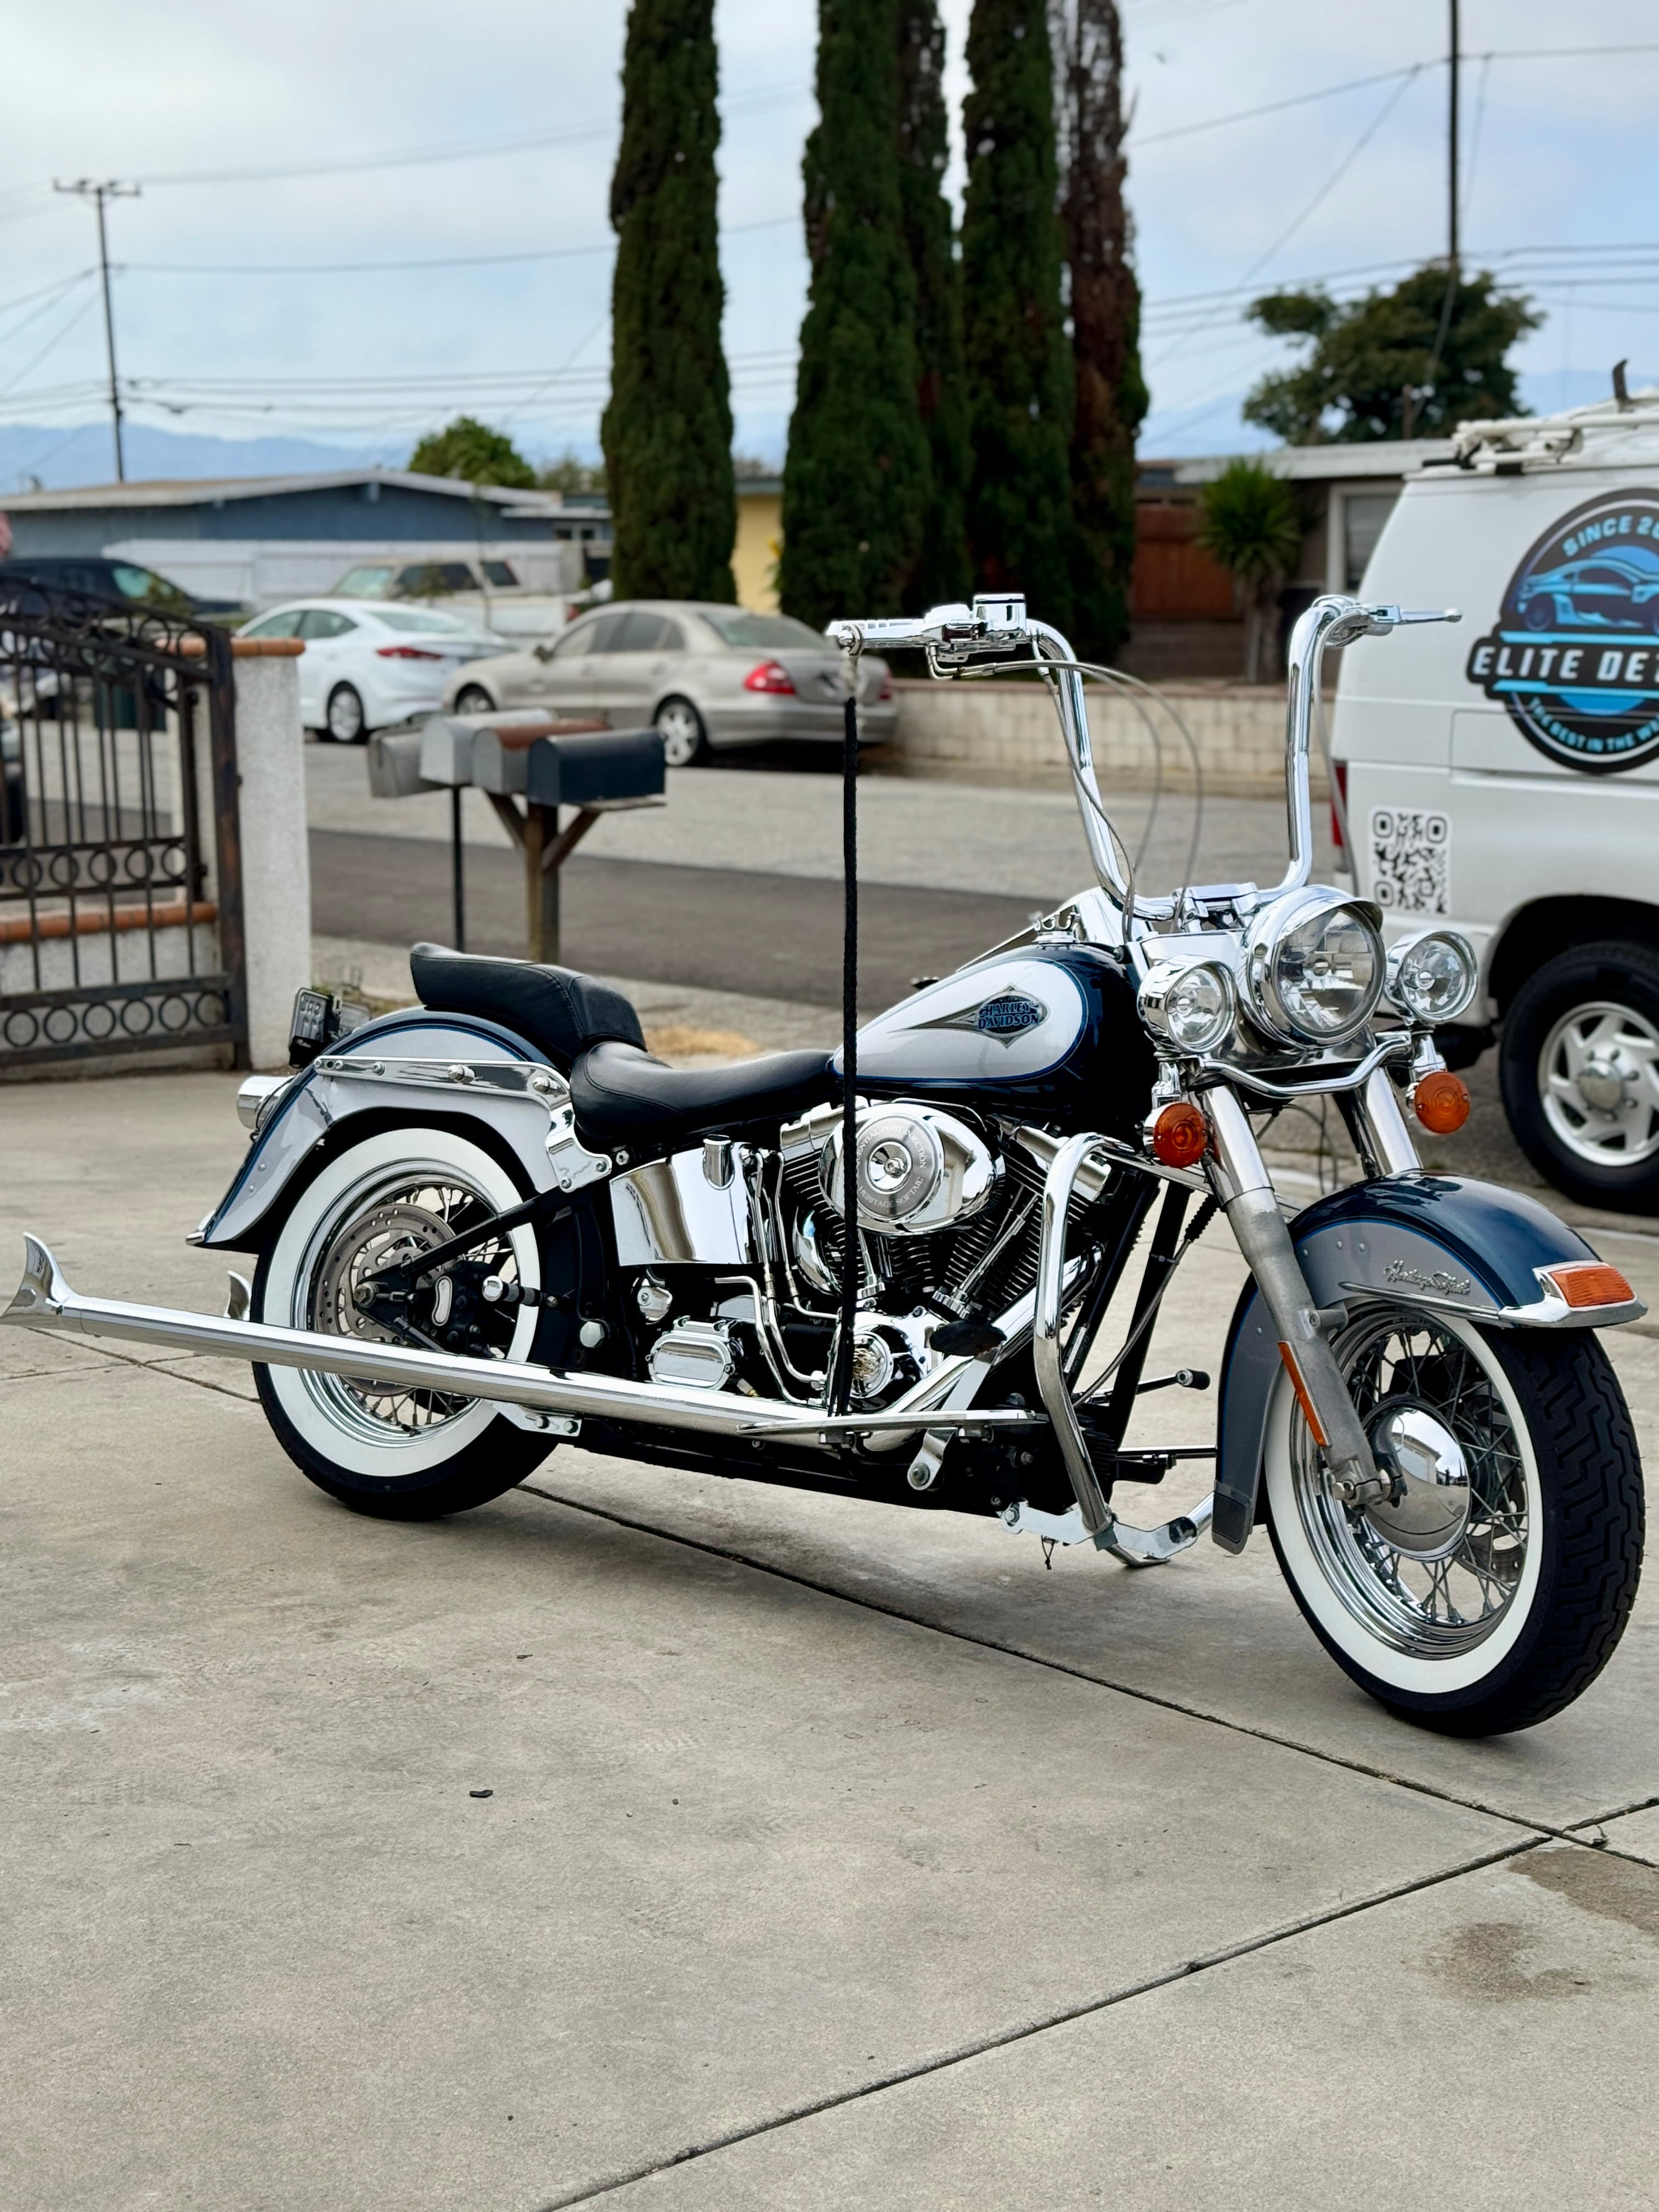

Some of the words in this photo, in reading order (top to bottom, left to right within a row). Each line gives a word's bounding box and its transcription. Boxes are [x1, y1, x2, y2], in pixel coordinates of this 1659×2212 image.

[1562, 515, 1633, 557] SINCE
[1472, 646, 1584, 679] ELITE
[1596, 650, 1659, 683] DE
[1549, 721, 1586, 749] BEST
[1587, 737, 1604, 753] IN
[1606, 732, 1635, 752] THE
[978, 1013, 1040, 1030] DAVIDSON
[859, 1186, 895, 1207] HERITAGE
[896, 1176, 924, 1205] SOFTAIL
